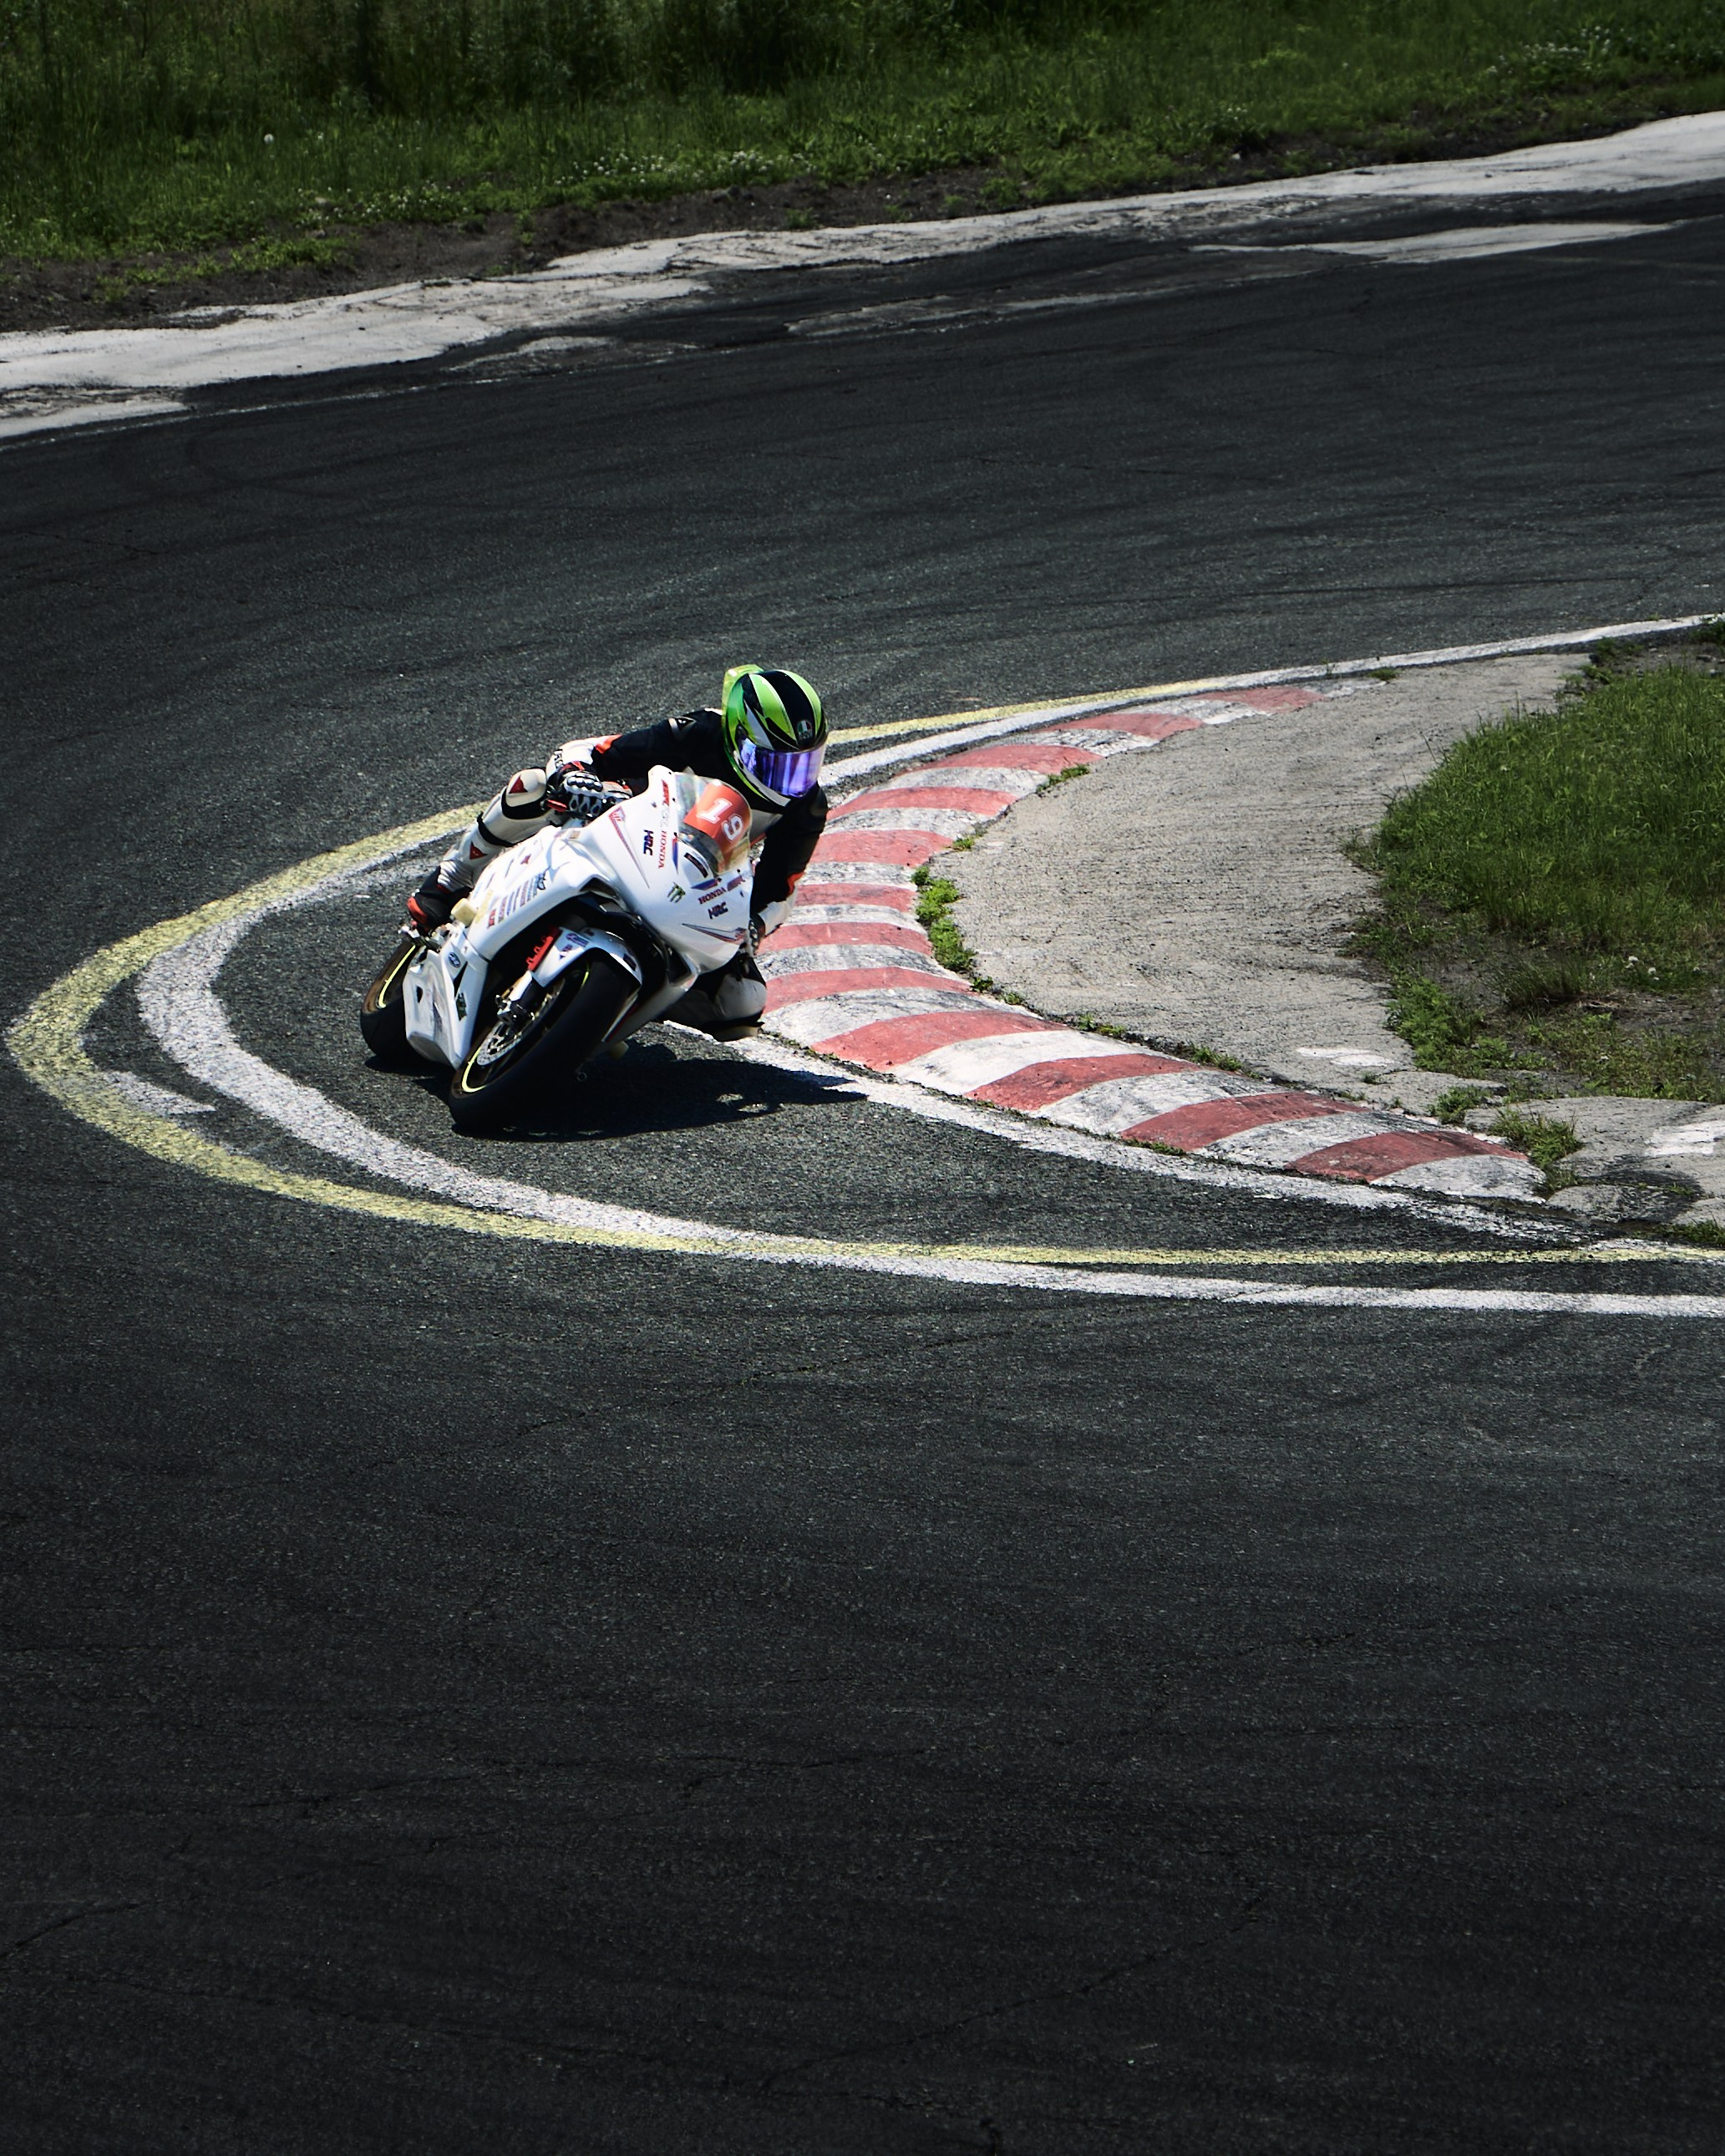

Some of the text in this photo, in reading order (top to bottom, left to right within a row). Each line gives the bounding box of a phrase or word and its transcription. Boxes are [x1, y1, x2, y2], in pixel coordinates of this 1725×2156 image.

[696, 798, 743, 843] 19
[644, 829, 654, 855] HRC
[658, 830, 667, 869] HONDA
[698, 887, 727, 904] HONDA
